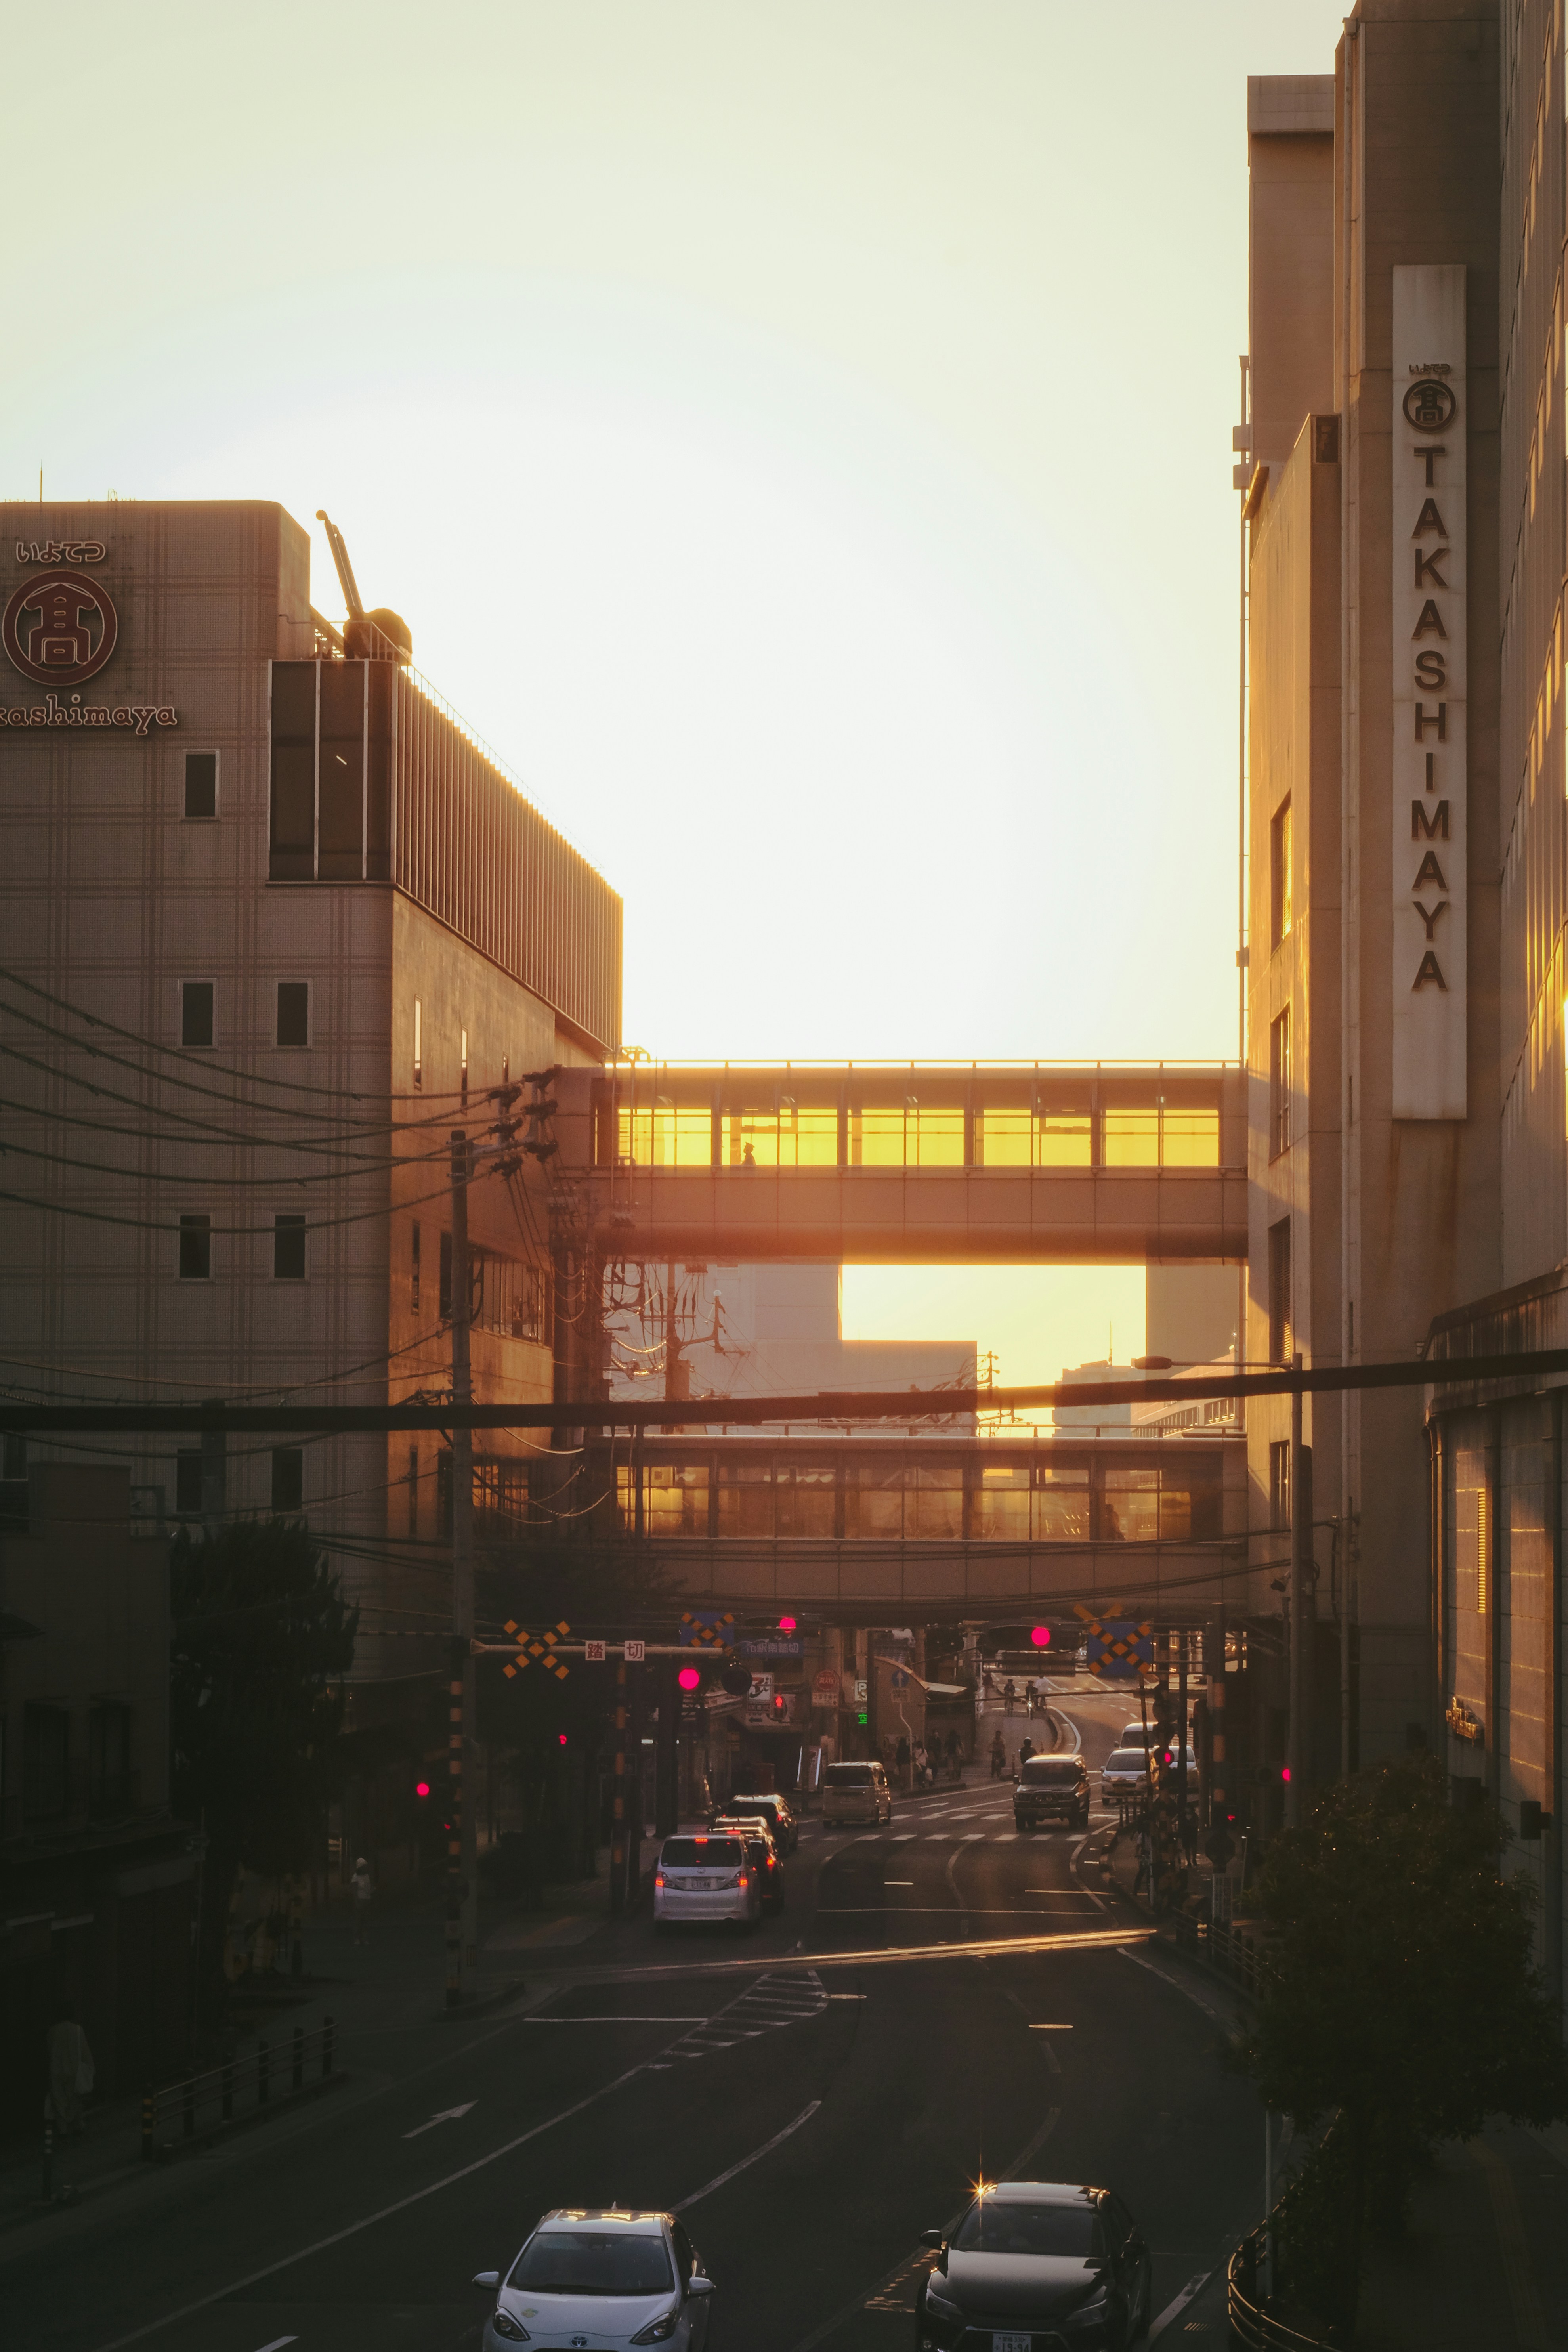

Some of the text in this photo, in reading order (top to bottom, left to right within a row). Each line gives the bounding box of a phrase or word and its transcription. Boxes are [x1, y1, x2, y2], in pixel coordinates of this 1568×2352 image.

[1409, 363, 1451, 374] いよてつ
[16, 541, 106, 563] いよてつ
[1411, 447, 1450, 991] TAKASHIMAYA
[858, 1713, 867, 1724] 空
